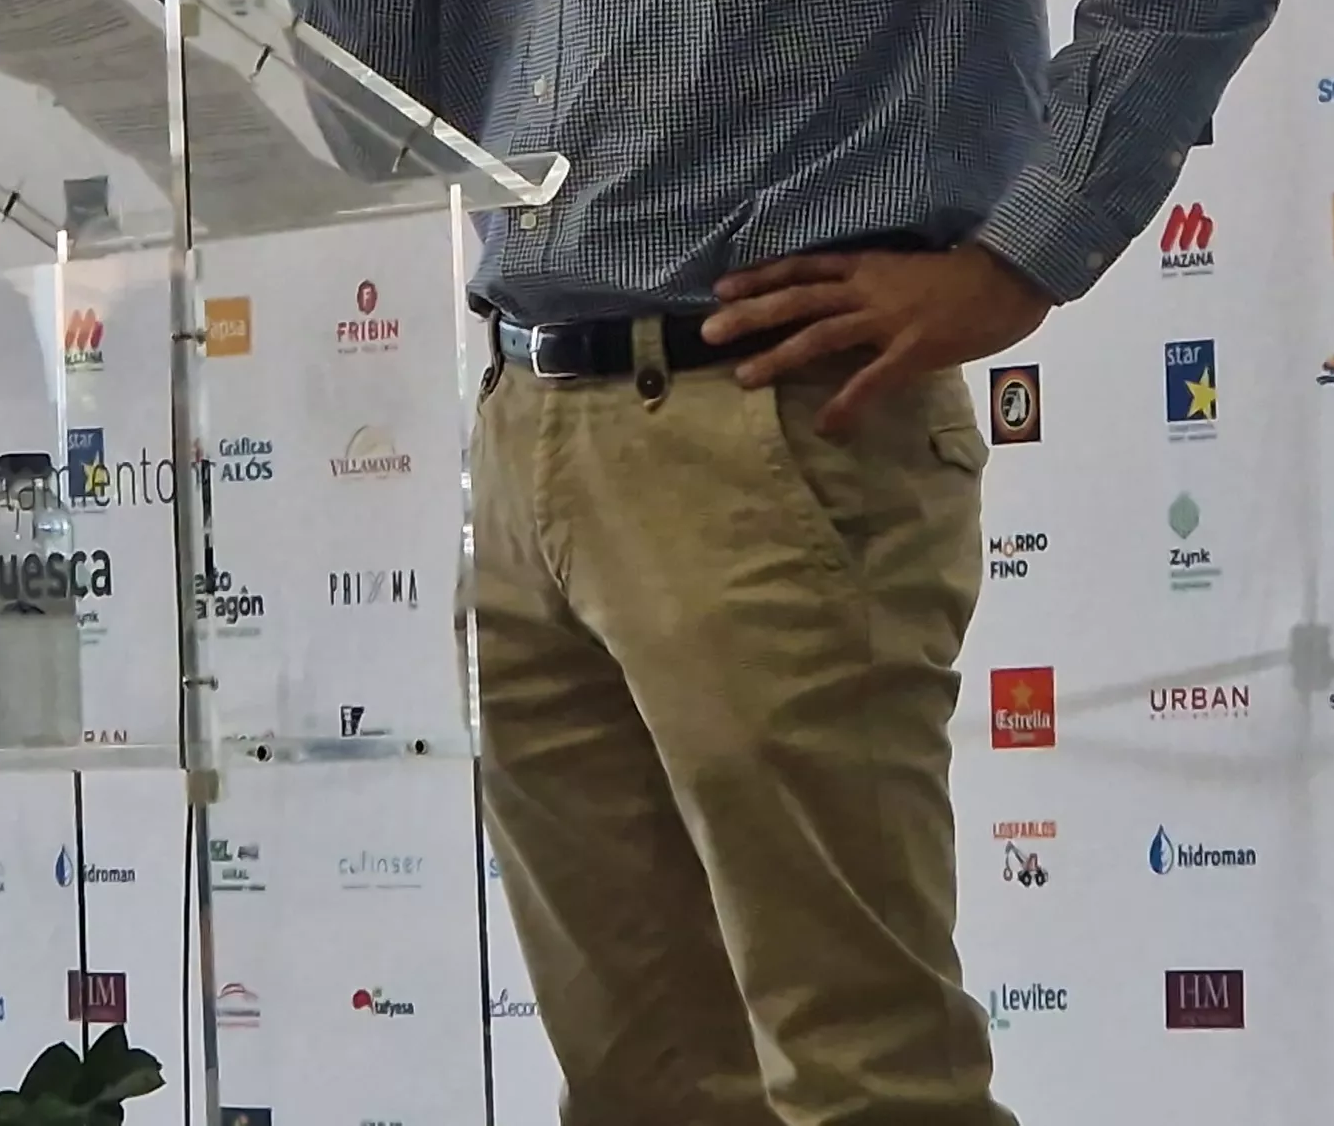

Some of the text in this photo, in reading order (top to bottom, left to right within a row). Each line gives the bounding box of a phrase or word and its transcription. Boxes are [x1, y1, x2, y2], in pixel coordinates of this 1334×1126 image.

[1167, 345, 1203, 366] star
[989, 559, 1029, 580] FINO
[1169, 548, 1212, 567] Zynk
[1150, 685, 1251, 712] URBAN
[995, 708, 1052, 732] Estrella
[1177, 843, 1257, 869] hidroman
[1002, 982, 1068, 1012] levitec
[1178, 973, 1230, 1009] HM
